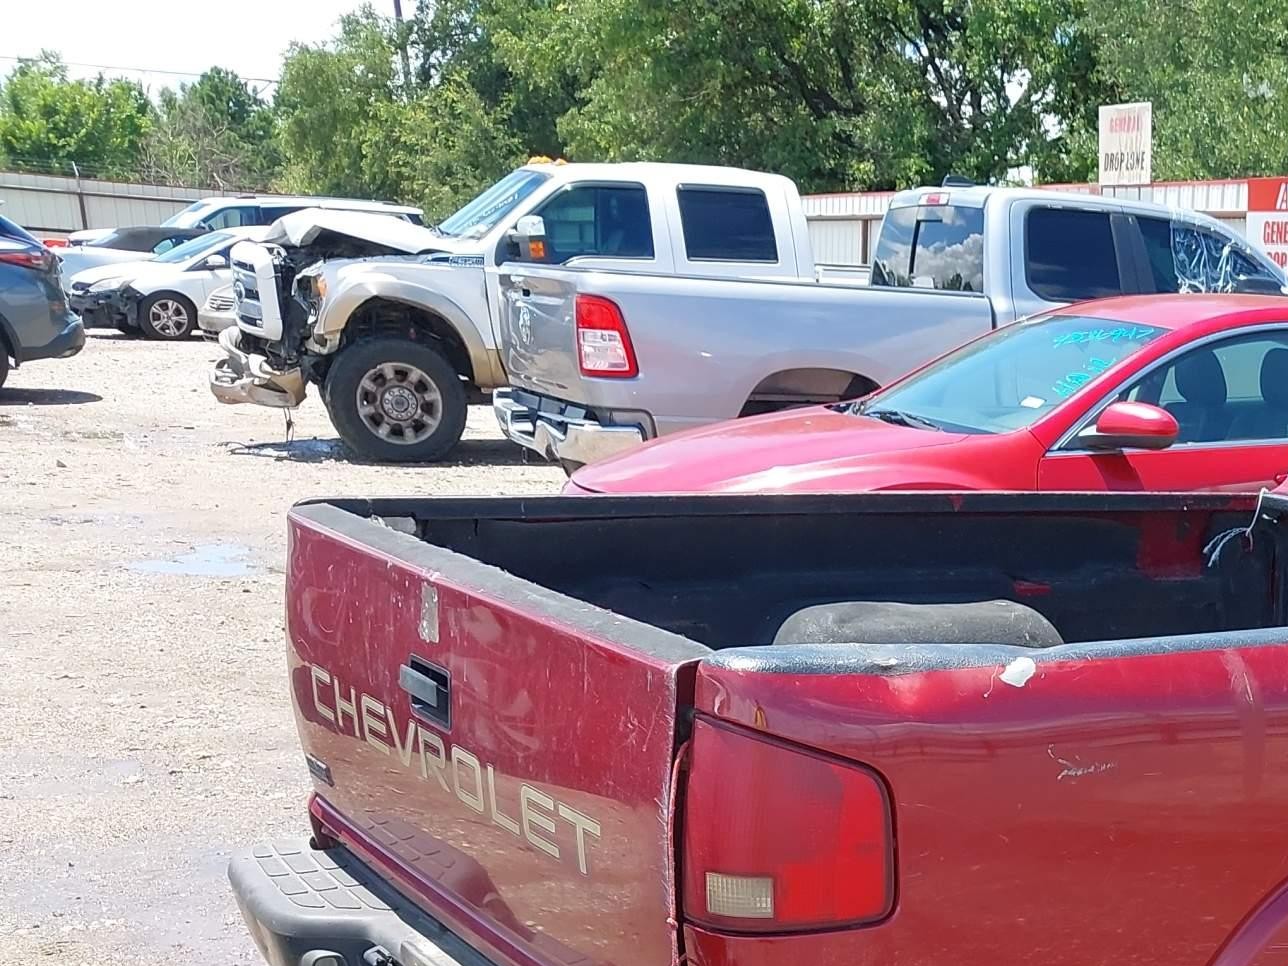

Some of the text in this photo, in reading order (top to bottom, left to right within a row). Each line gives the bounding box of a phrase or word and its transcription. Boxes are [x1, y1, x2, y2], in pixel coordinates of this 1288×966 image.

[1104, 151, 1146, 172] DROP ZONE
[310, 664, 602, 876] CHEVROLET
